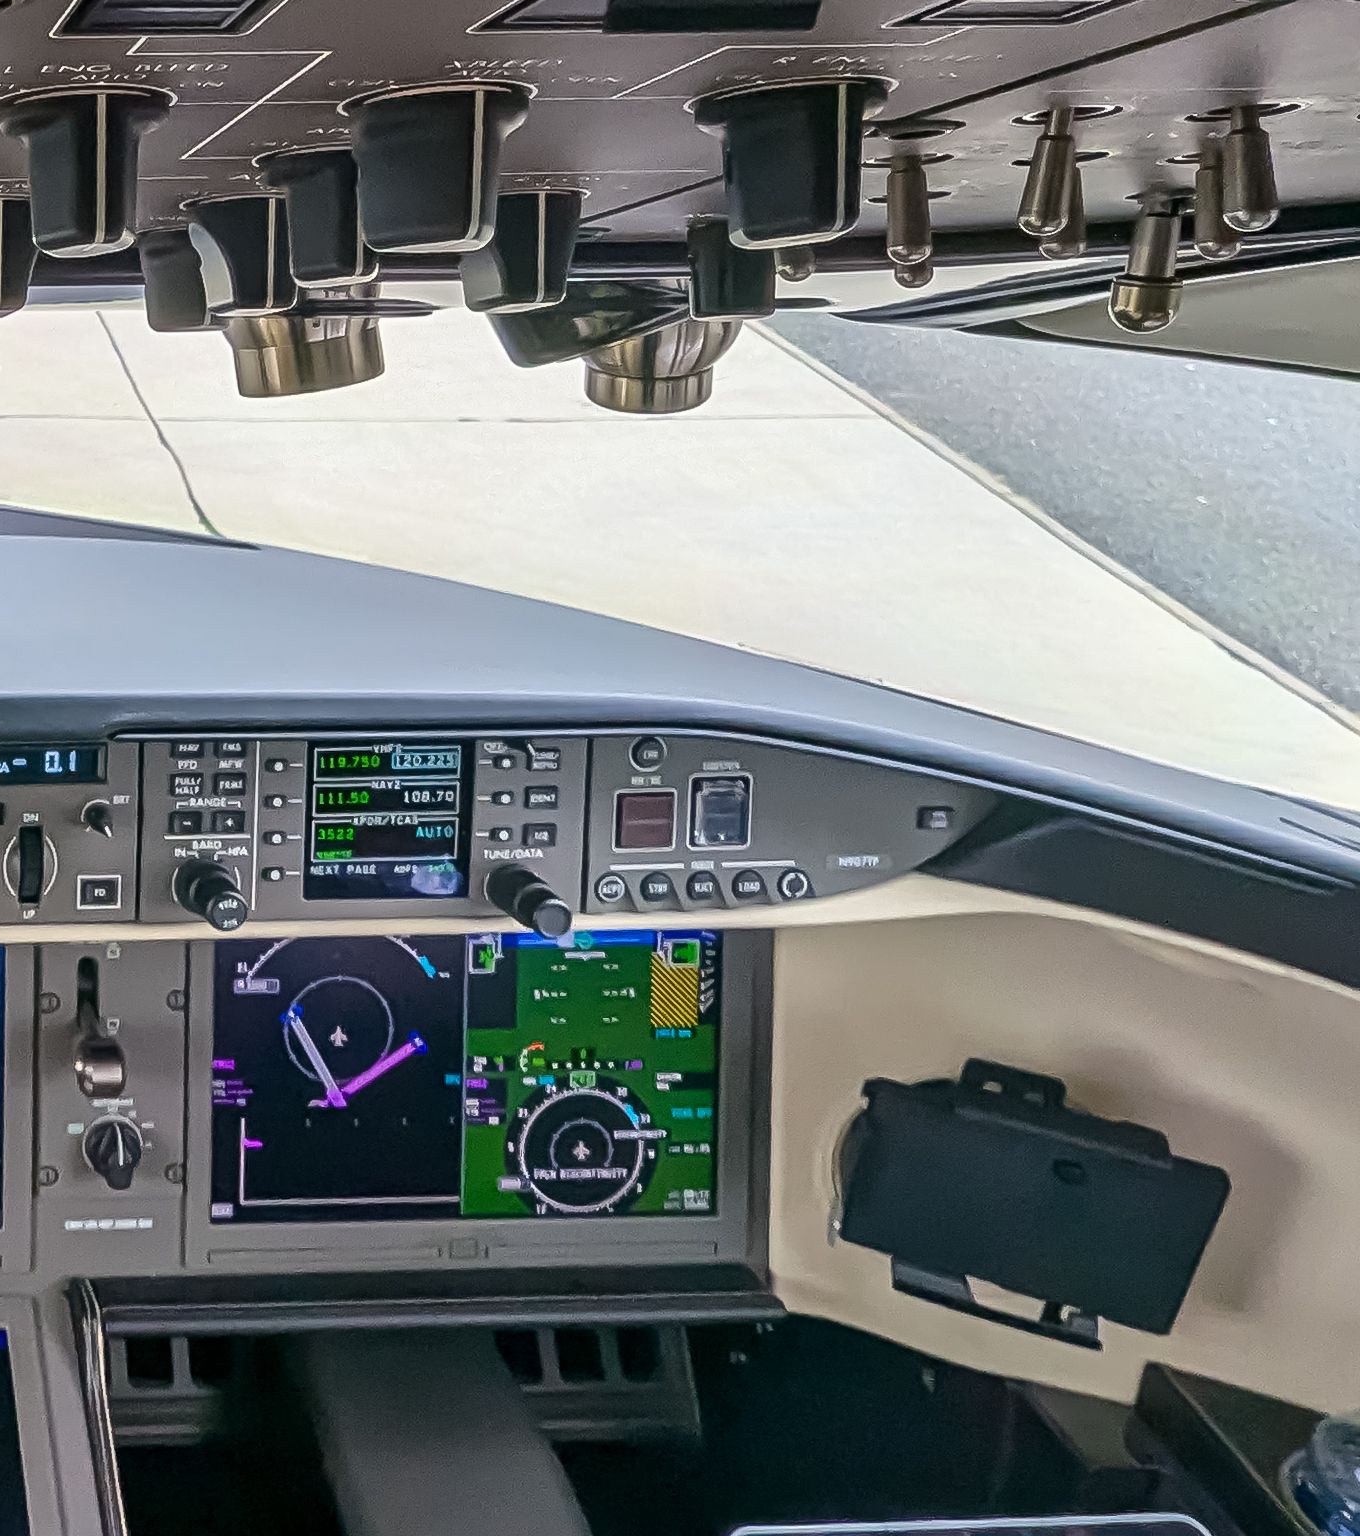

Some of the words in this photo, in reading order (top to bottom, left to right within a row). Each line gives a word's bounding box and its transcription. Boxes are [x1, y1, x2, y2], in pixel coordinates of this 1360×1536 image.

[39, 63, 113, 74] ENG
[44, 750, 78, 773] 0.1
[320, 755, 381, 769] 119.750
[189, 797, 227, 808] RANGE
[318, 791, 370, 805] 111.50
[317, 827, 355, 841] 3522
[415, 825, 454, 839] AUTO
[482, 848, 545, 859] TUNE/DATA
